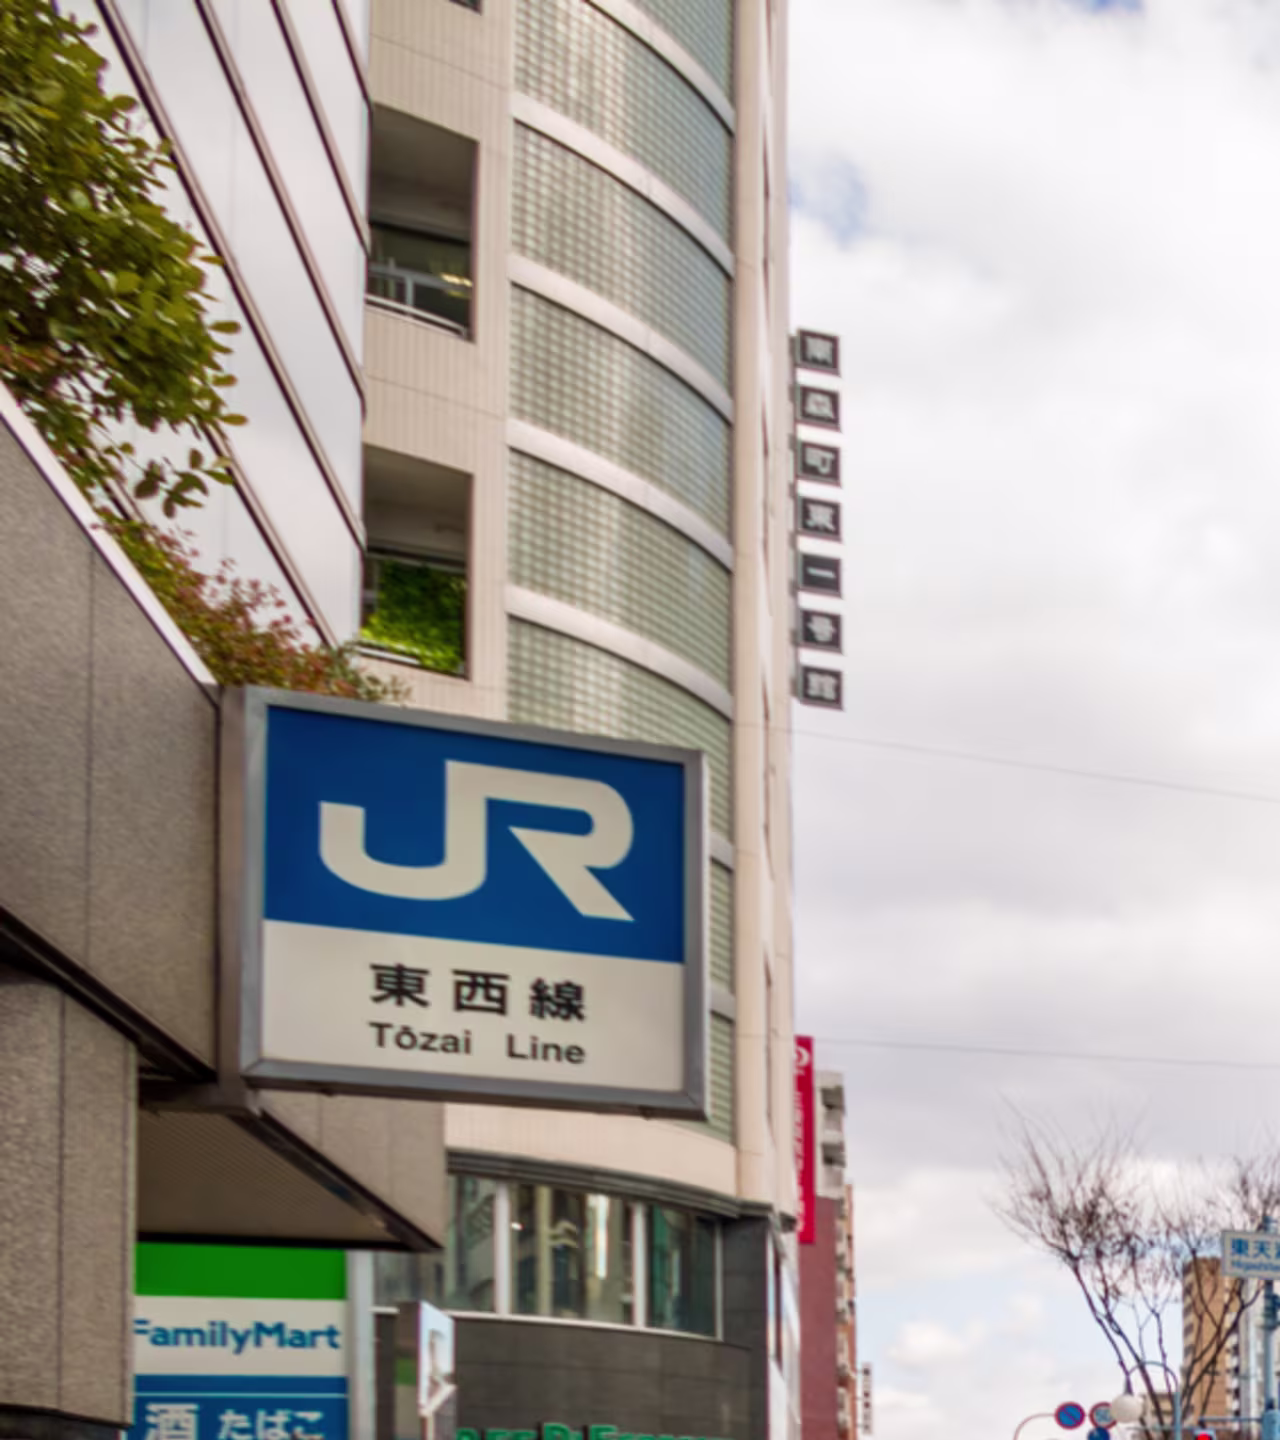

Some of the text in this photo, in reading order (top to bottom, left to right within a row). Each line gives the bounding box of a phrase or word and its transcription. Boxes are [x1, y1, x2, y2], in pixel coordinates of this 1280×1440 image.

[319, 759, 636, 922] JR
[370, 963, 587, 1022] 東西線
[369, 1021, 587, 1065] Tōzai Line
